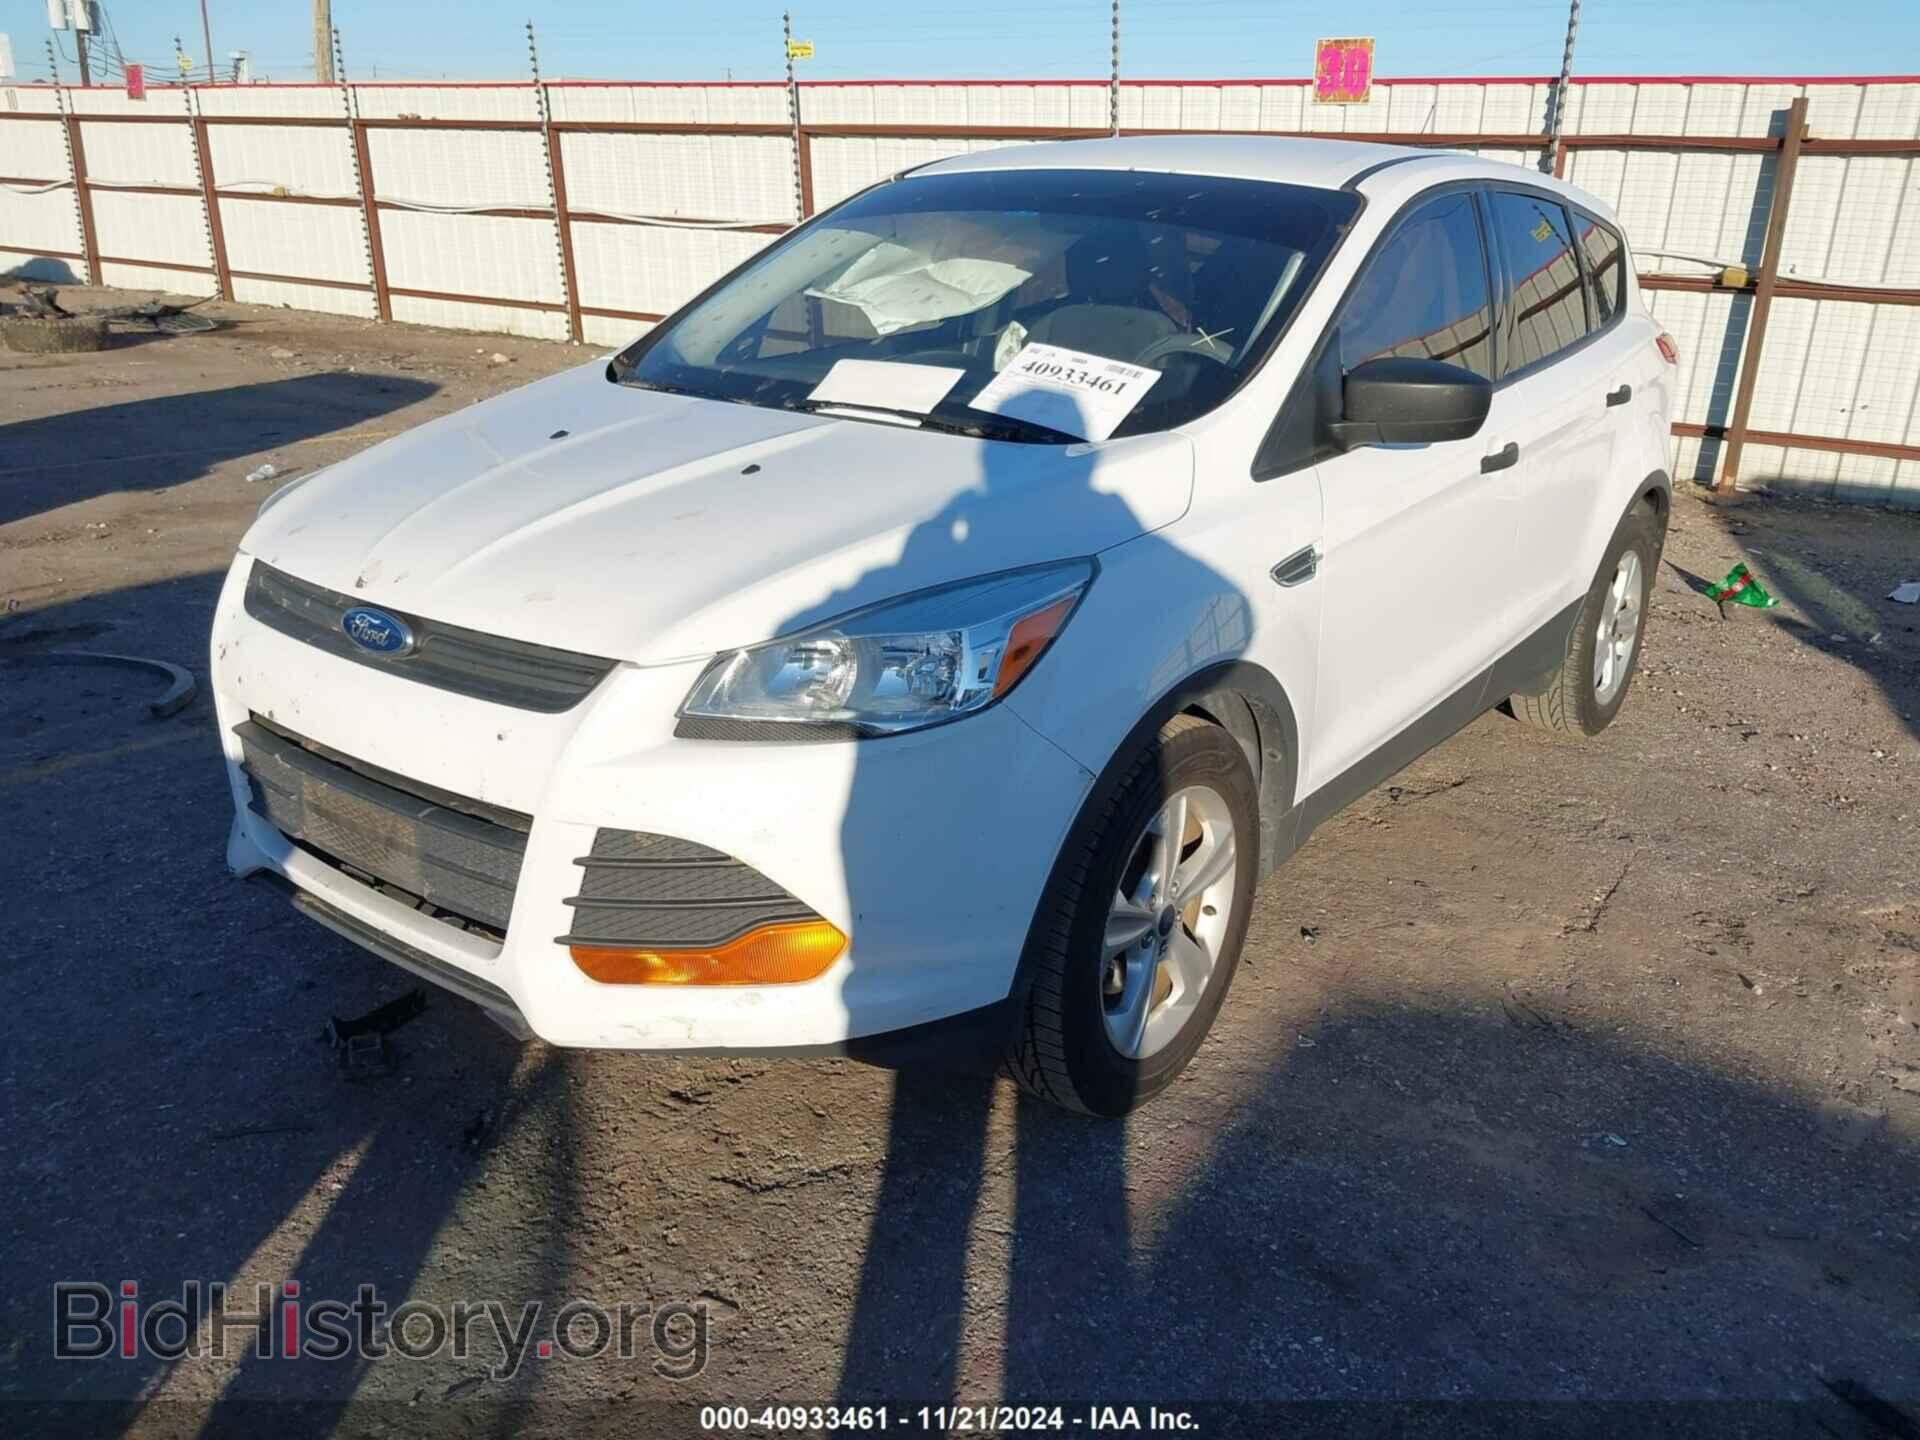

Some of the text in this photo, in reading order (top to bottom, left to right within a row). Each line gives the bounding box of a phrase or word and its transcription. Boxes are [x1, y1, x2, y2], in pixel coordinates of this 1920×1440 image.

[1317, 47, 1370, 97] 30
[1021, 360, 1128, 396] 40933461
[350, 612, 391, 648] Ford
